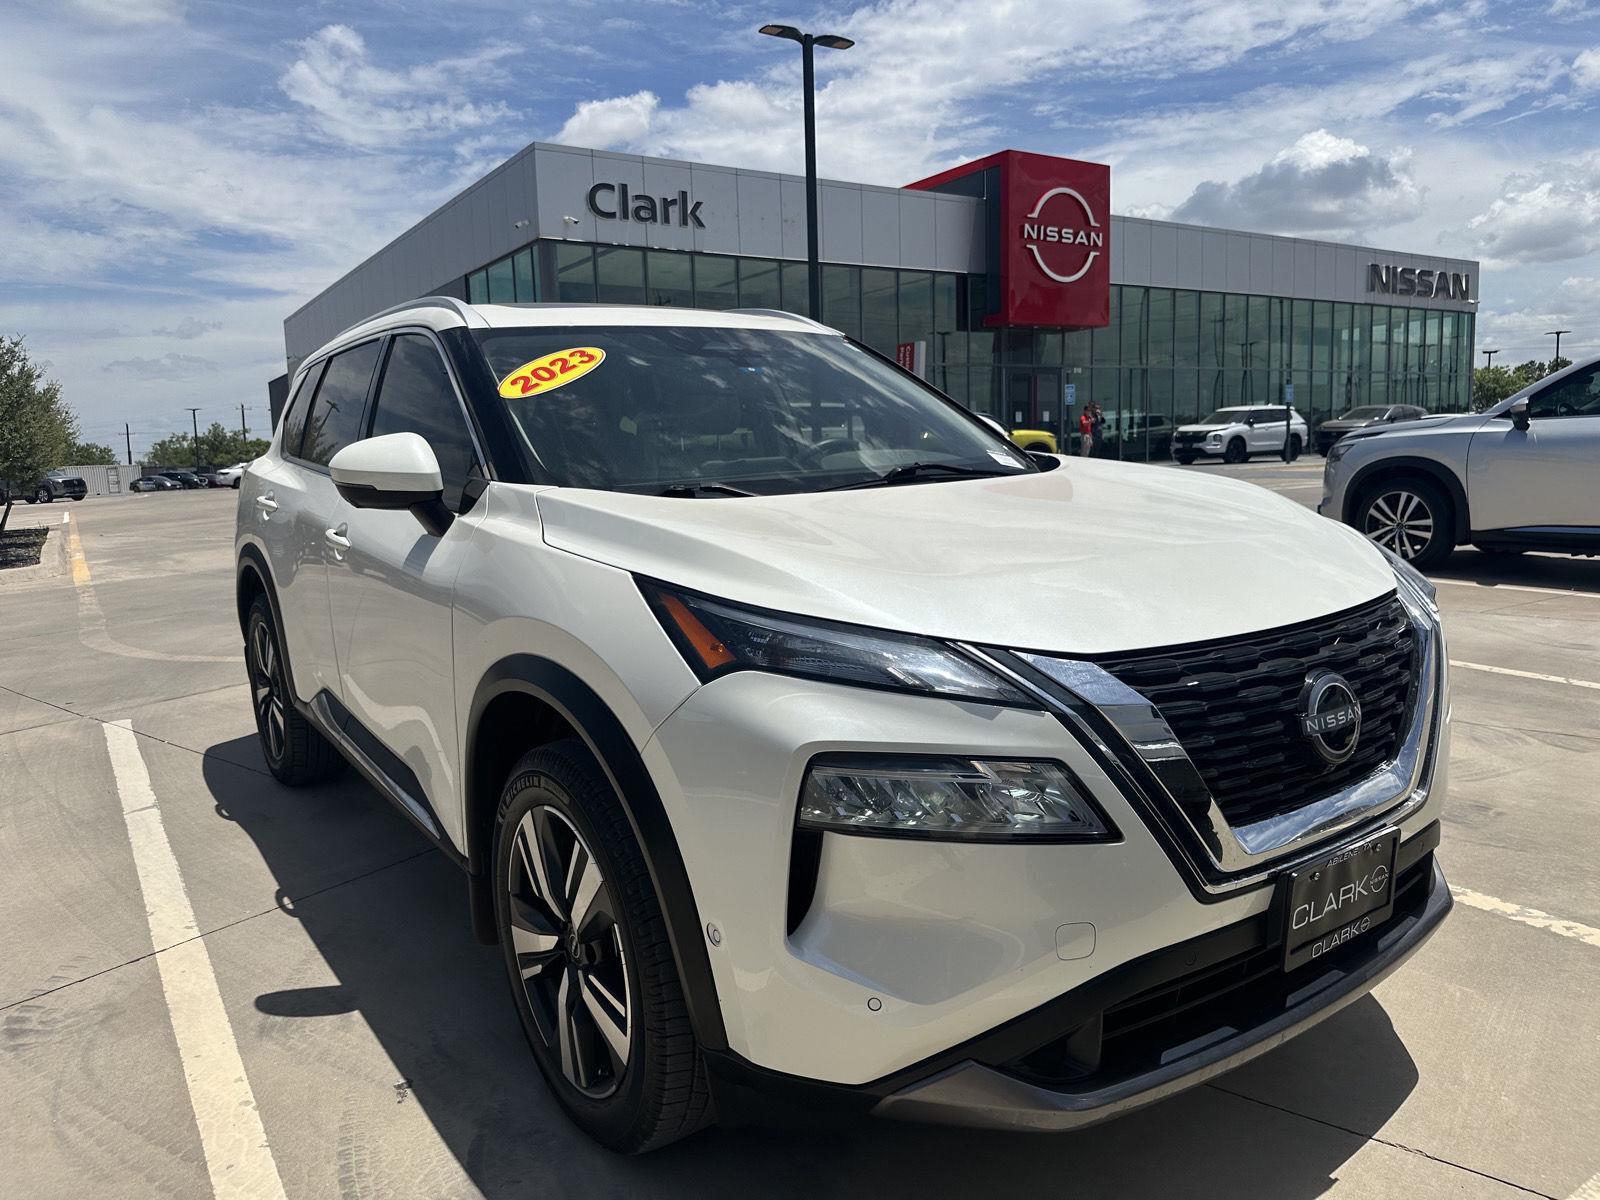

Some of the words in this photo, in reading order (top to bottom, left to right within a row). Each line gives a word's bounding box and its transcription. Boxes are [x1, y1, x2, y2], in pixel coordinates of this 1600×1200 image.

[587, 183, 705, 228] Clark
[1024, 223, 1102, 247] NISSAN
[1369, 263, 1469, 301] NISSAN
[510, 350, 597, 394] 2023
[1306, 706, 1361, 732] NISSAN
[505, 775, 540, 808] MICHELIN
[1292, 875, 1368, 930] CLARK
[1312, 921, 1360, 958] CLARK
